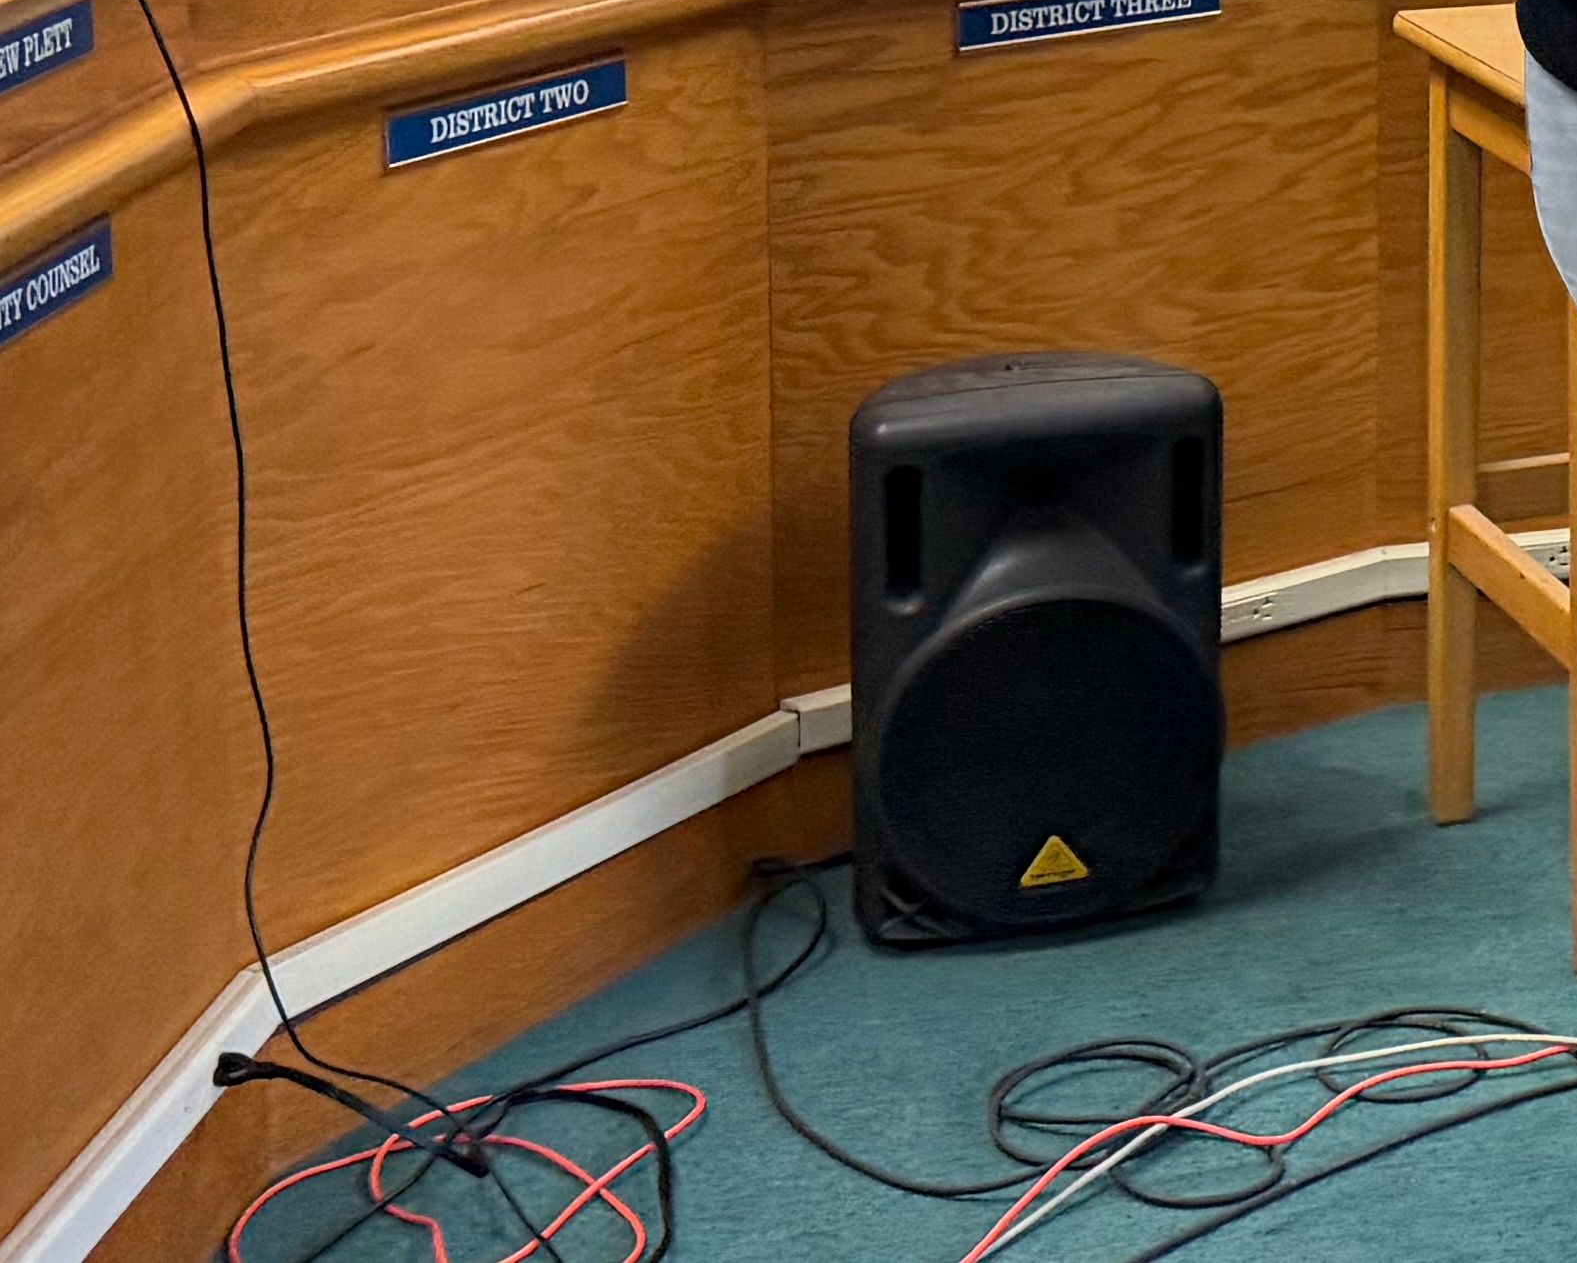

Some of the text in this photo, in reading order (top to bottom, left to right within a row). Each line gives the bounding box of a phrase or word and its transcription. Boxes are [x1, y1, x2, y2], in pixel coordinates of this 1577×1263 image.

[22, 17, 73, 67] PLETT
[991, 0, 1105, 35] DISTRICT
[429, 79, 590, 144] DISTRICT TWO
[26, 244, 101, 311] COUNSEL
